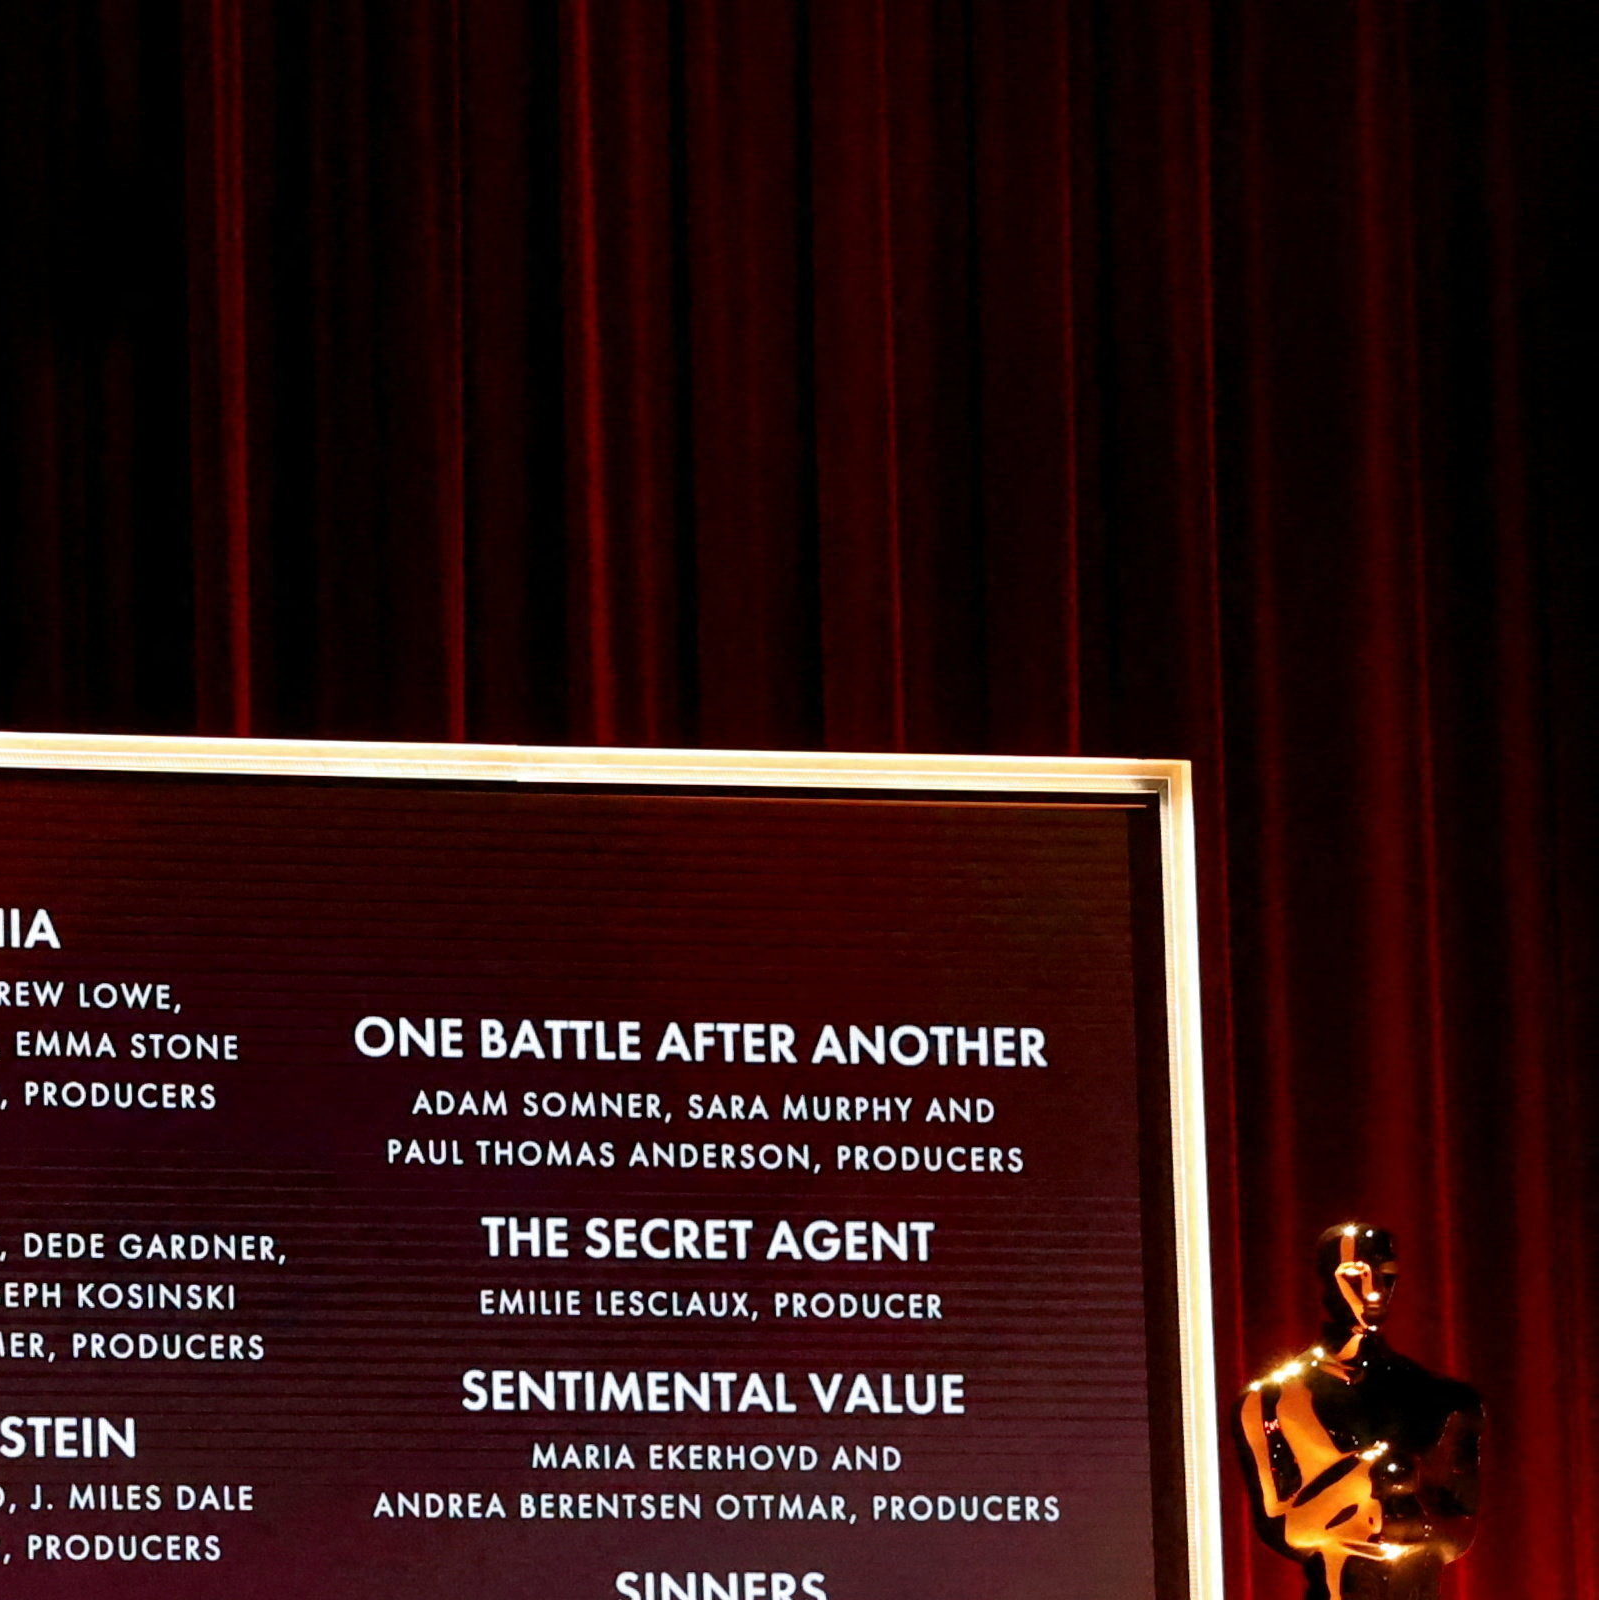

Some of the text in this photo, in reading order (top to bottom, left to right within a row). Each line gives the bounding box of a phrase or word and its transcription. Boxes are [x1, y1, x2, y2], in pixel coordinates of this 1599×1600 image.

[79, 982, 181, 1014] LOWE,
[16, 1030, 117, 1058] EMMA
[130, 1033, 238, 1060] STONE
[354, 1015, 1048, 1067] ONE BATTLE AFTER ANOTHER
[25, 1081, 216, 1110] PRODUCERS
[412, 1090, 995, 1124] ADAM SOMNER, SARA MURPHY AND
[388, 1138, 1024, 1174] PAUL THOMAS ANDERSON, PRODUCERS
[24, 1232, 105, 1259] DEDE
[119, 1233, 286, 1265] GARDNER,
[480, 1216, 935, 1262] THE SECRET AGENT
[77, 1283, 235, 1310] KOSINSKI
[480, 1289, 942, 1322] EMILIE LESCLAUX, PRODUCER
[72, 1333, 264, 1360] PRODUCERS
[462, 1369, 965, 1415] SENTIMENTAL VALUE
[532, 1442, 902, 1472] MARIA EKERHOVD AND
[30, 1484, 53, 1510] J.
[69, 1484, 162, 1511] MILES
[176, 1485, 253, 1511] DALE
[373, 1492, 1060, 1525] ANDREA BERENTSEN OTTMAR, PRODUCERS
[28, 1534, 221, 1561] PRODUCERS
